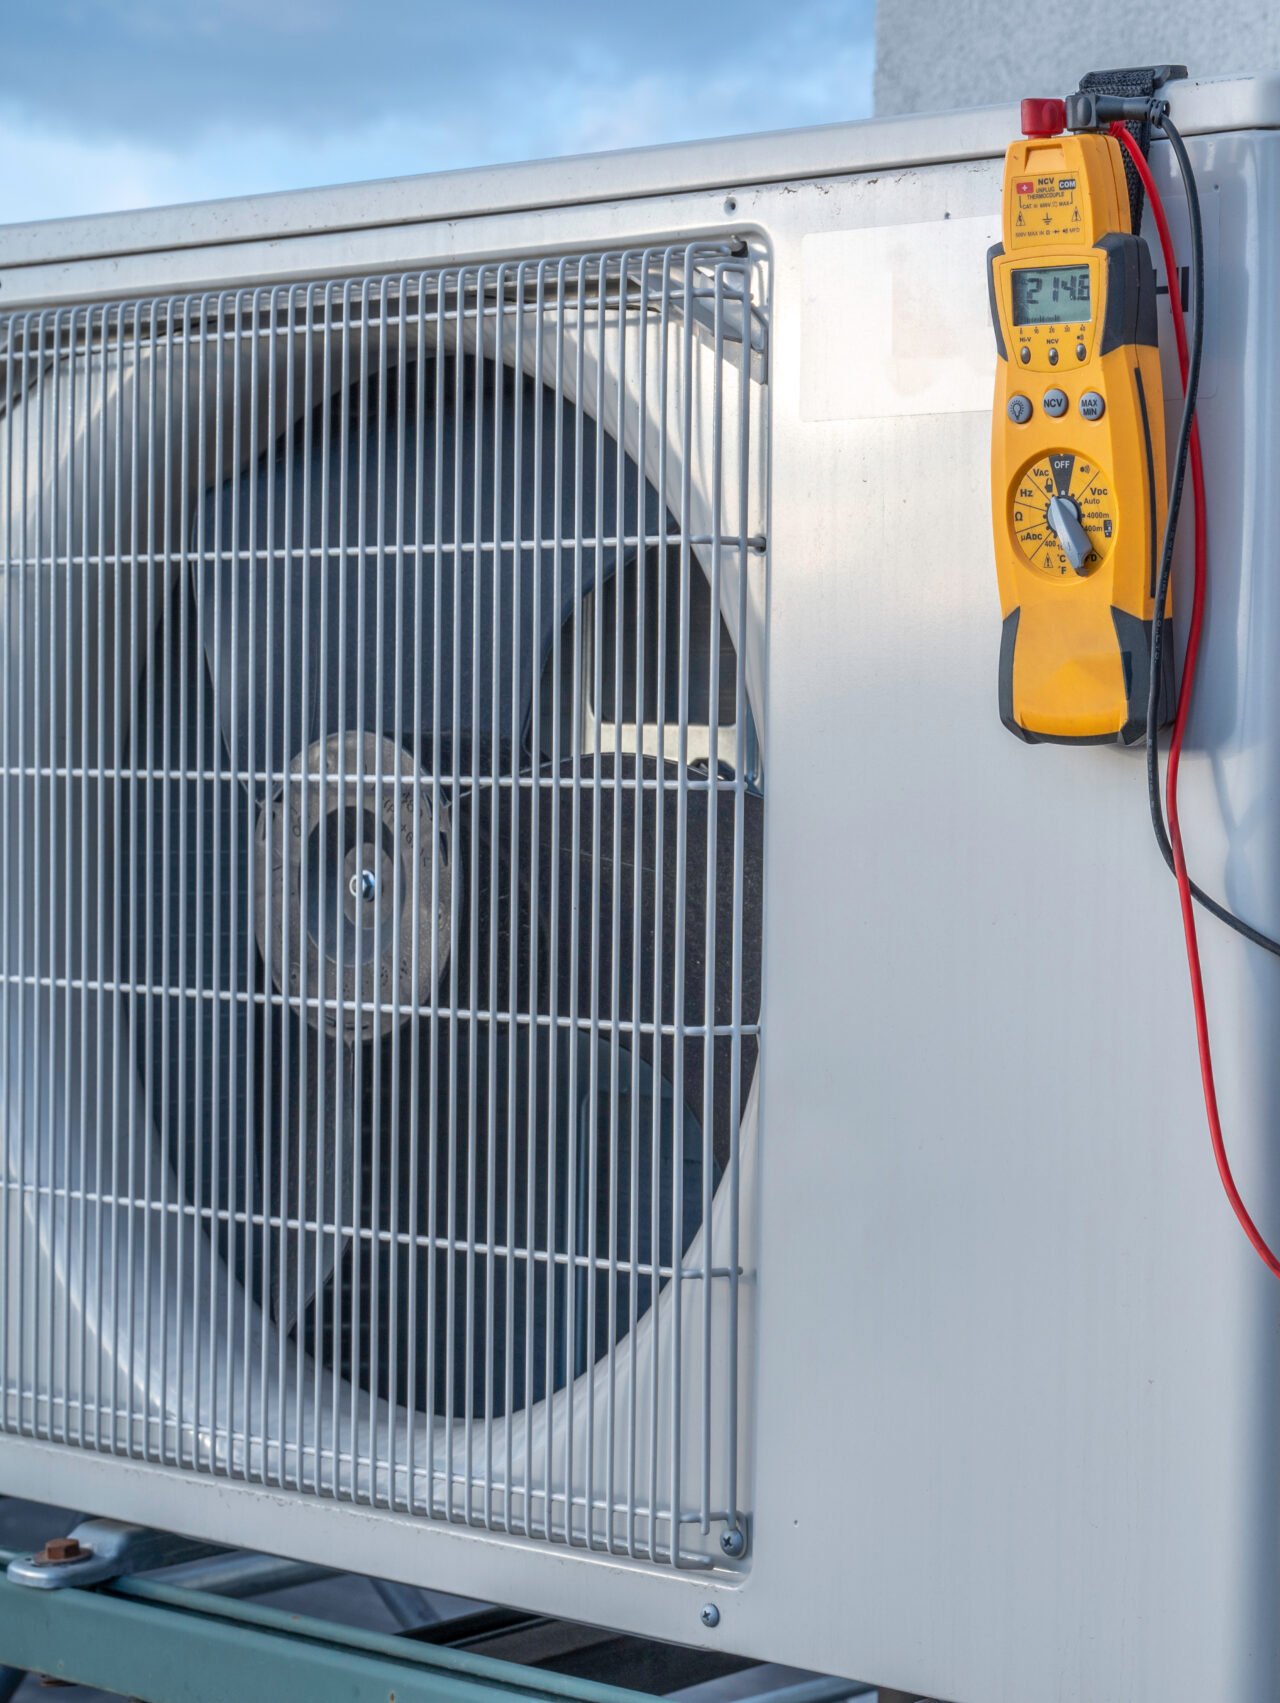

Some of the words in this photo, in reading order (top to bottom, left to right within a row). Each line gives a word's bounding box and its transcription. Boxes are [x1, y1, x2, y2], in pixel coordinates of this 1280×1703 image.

[1038, 177, 1054, 185] NCV
[1059, 180, 1076, 188] COM
[1044, 398, 1063, 408] NCV
[1081, 399, 1098, 407] MAX
[1083, 408, 1097, 416] MIN
[1054, 461, 1070, 469] OFF
[1020, 488, 1033, 497] Hz
